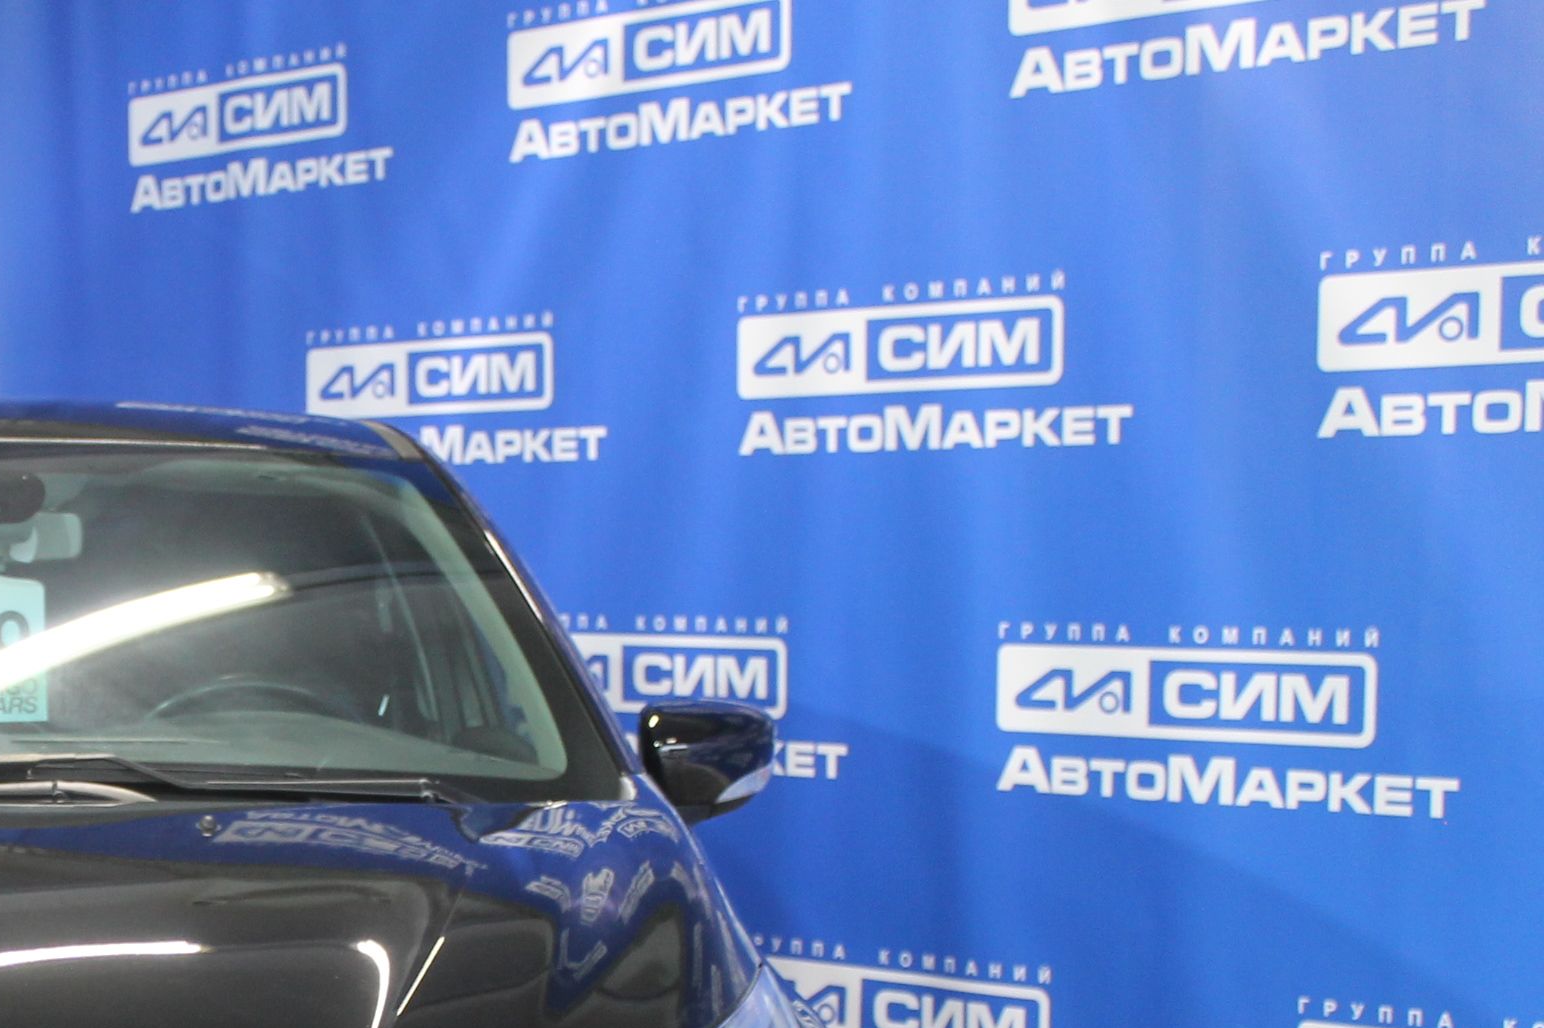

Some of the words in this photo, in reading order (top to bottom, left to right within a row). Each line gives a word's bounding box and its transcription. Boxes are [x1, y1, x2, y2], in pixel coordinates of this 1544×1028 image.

[634, 8, 771, 70] СИМ
[225, 82, 331, 133] СИМ
[1320, 241, 1476, 269] ГРУППА
[738, 289, 849, 312] ГРУППА
[883, 271, 1065, 300] КОМПАНИЙ
[879, 317, 1040, 371] СИМ
[416, 351, 536, 397] СИМ
[998, 621, 1130, 641] ГРУППА
[1170, 625, 1380, 647] КОМПАНИЙ
[634, 653, 768, 699] СИМ
[1164, 670, 1350, 724] СИМ
[880, 950, 1051, 984] КОМПАНИЙ
